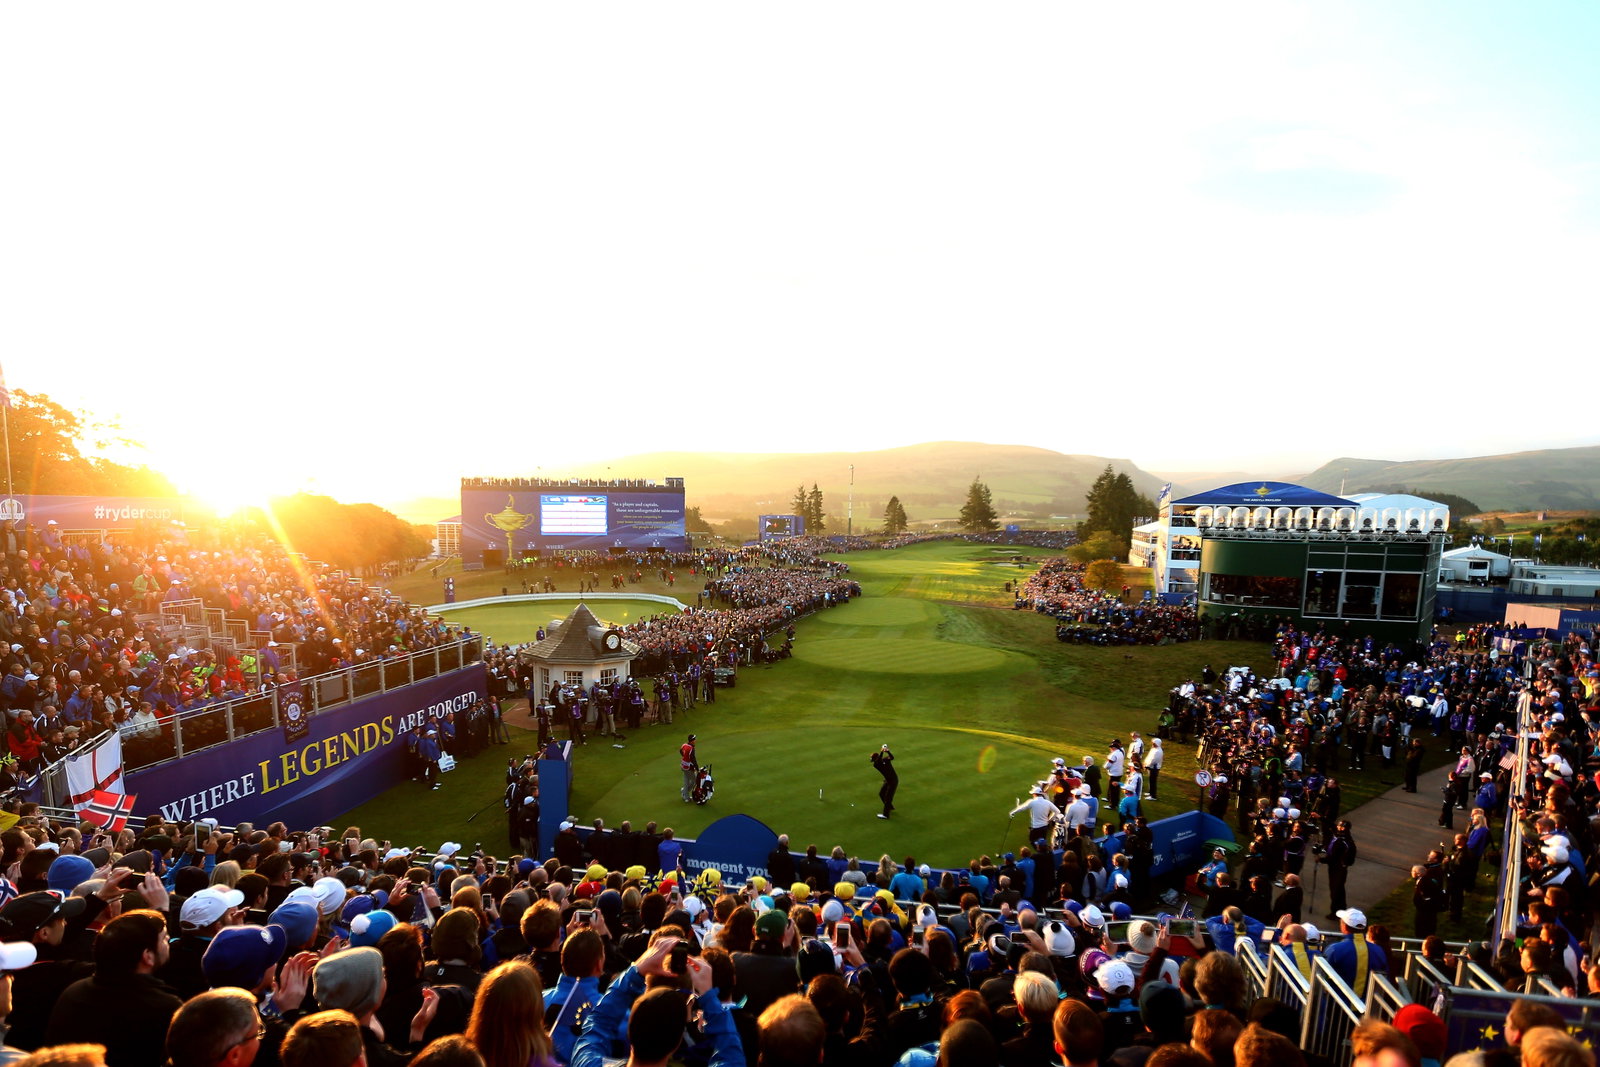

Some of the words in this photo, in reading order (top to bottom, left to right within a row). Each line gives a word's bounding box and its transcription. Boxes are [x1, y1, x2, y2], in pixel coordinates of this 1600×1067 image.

[94, 505, 171, 521] #rydercup
[160, 773, 255, 822] WHERE
[258, 715, 394, 795] LEGENDS
[398, 709, 425, 735] ARE
[428, 691, 477, 719] FORGED
[687, 858, 743, 874] moment
